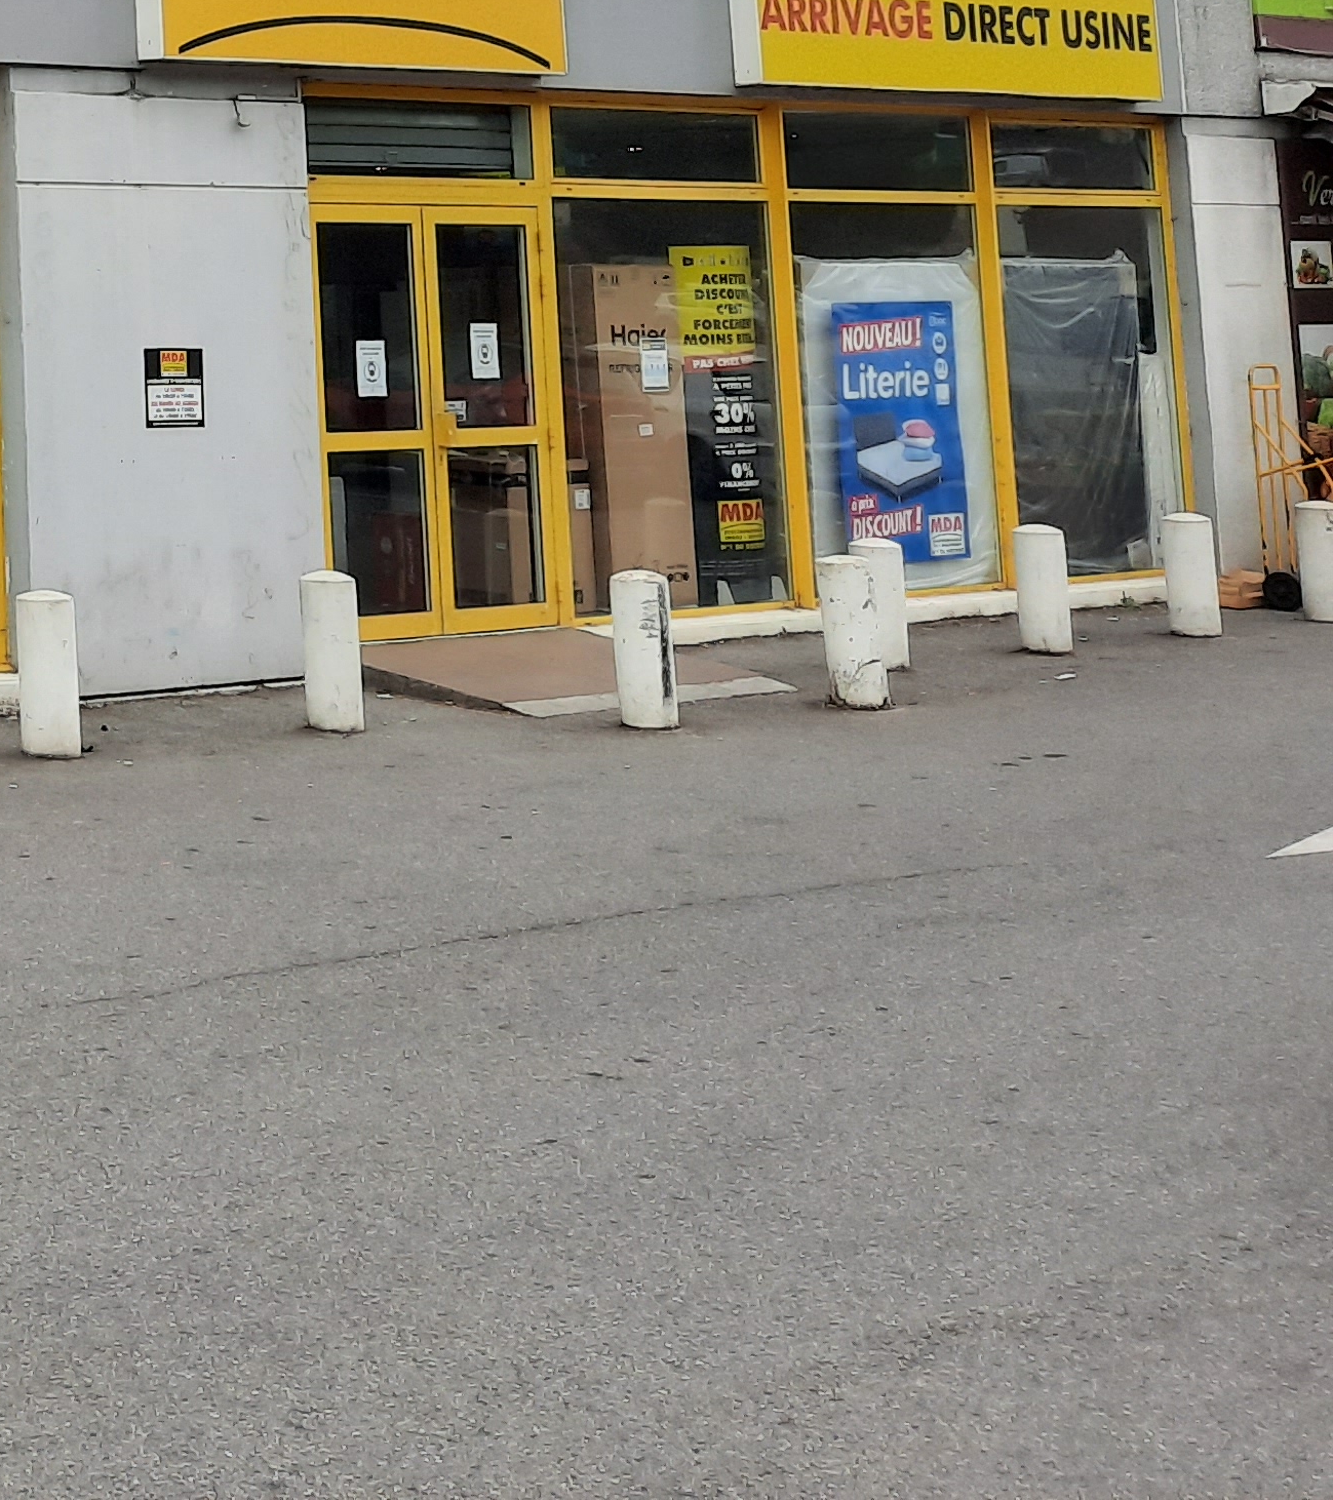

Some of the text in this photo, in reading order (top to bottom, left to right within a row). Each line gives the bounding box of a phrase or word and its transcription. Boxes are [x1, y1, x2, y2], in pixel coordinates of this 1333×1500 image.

[944, 1, 1049, 47] DIRECT
[1060, 8, 1153, 53] USINE
[684, 333, 733, 345] MOINS
[162, 352, 185, 363] MDA
[842, 361, 930, 400] Literie
[714, 402, 755, 424] 30%
[931, 516, 962, 534] MDA
